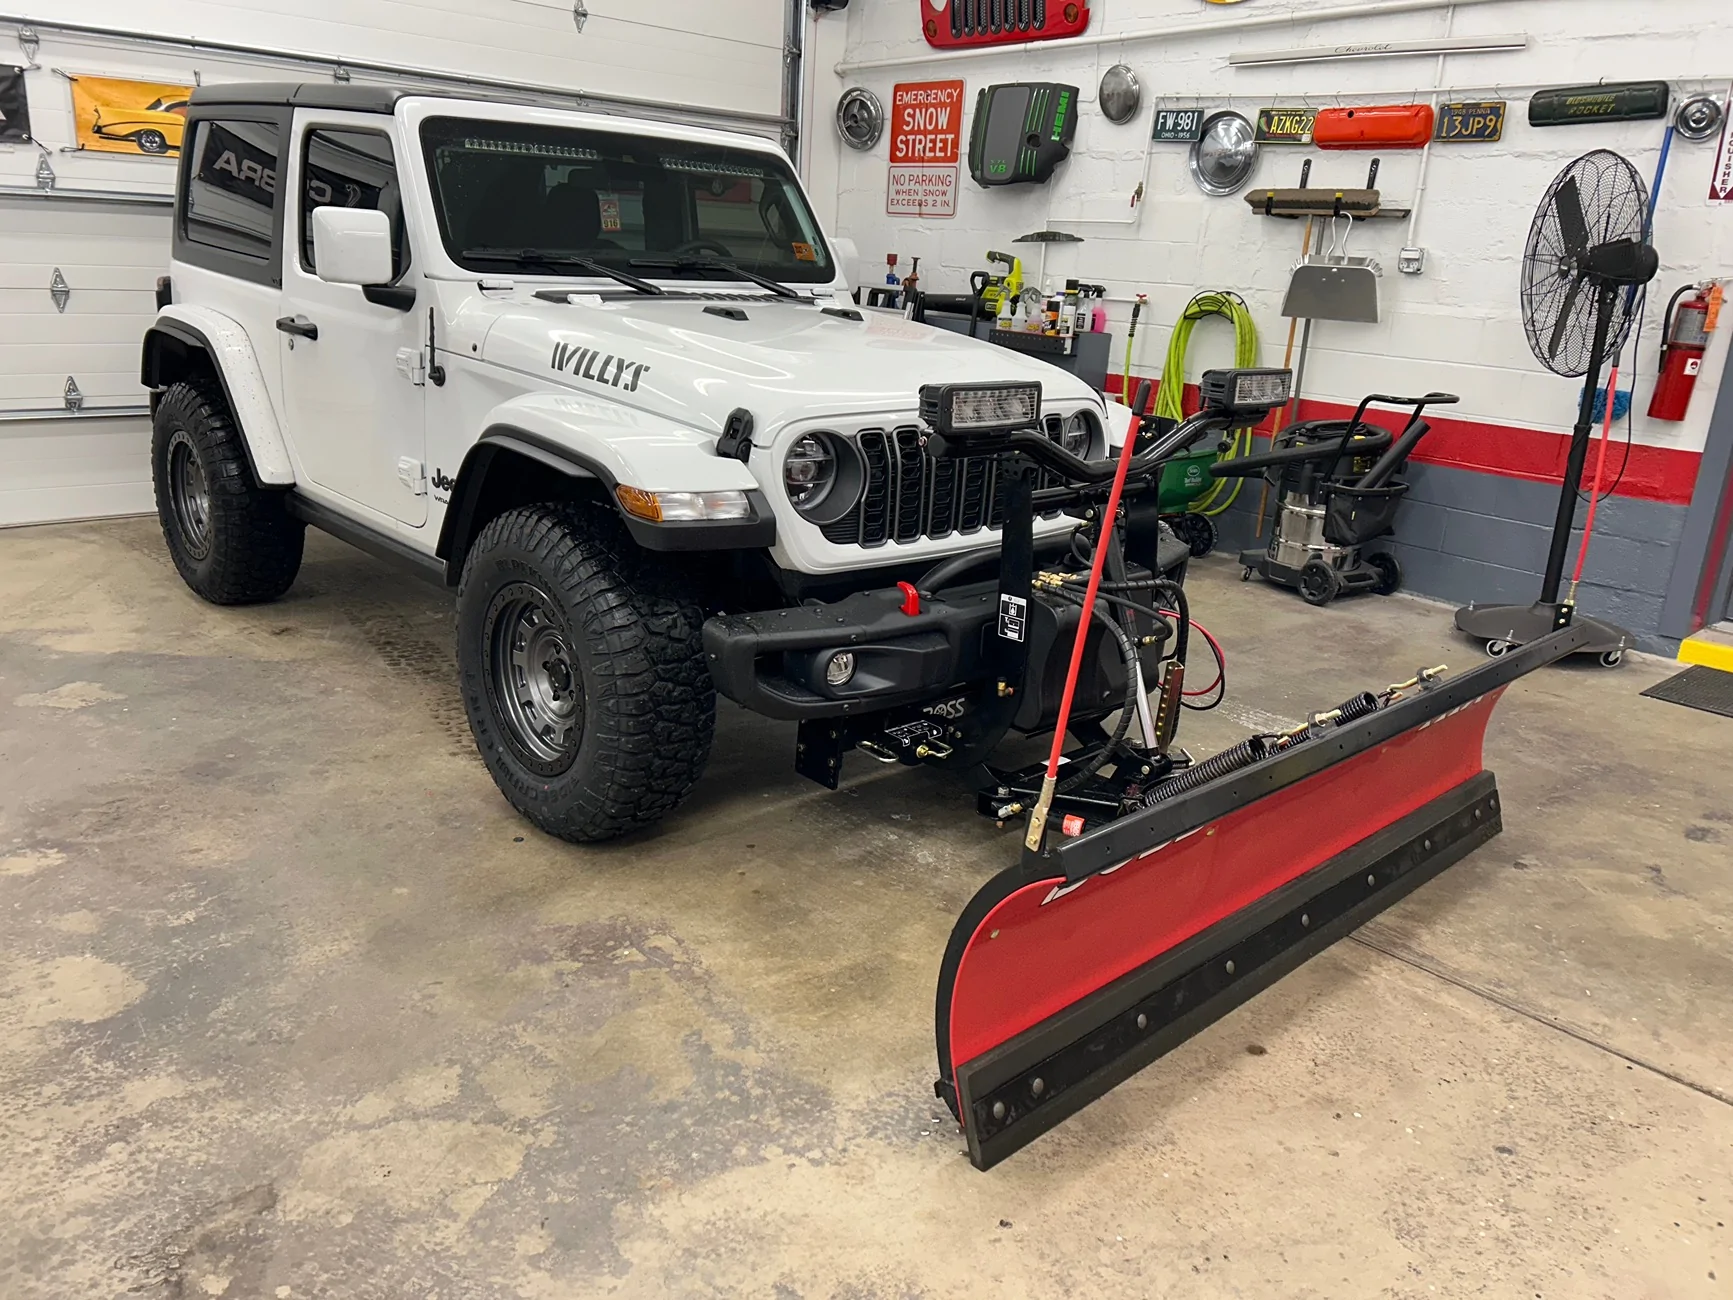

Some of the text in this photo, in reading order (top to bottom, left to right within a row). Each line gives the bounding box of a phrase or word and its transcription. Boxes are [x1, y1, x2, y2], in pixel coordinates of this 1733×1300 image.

[896, 88, 960, 105] EMERGENCY
[903, 106, 951, 131] SNOW
[1051, 91, 1070, 141] HEMI
[1568, 103, 1616, 115] ROCKET
[1269, 115, 1315, 134] AZKG22
[1440, 114, 1497, 137] 13JP9
[895, 134, 955, 158] STREET
[989, 164, 1007, 174] V8
[892, 173, 952, 188] NO PARKING
[895, 188, 948, 197] WHEN SNOW
[890, 198, 929, 208] EXCEEDS
[931, 199, 938, 208] 2
[550, 341, 652, 393] WILLYS
[431, 467, 457, 492] Jee
